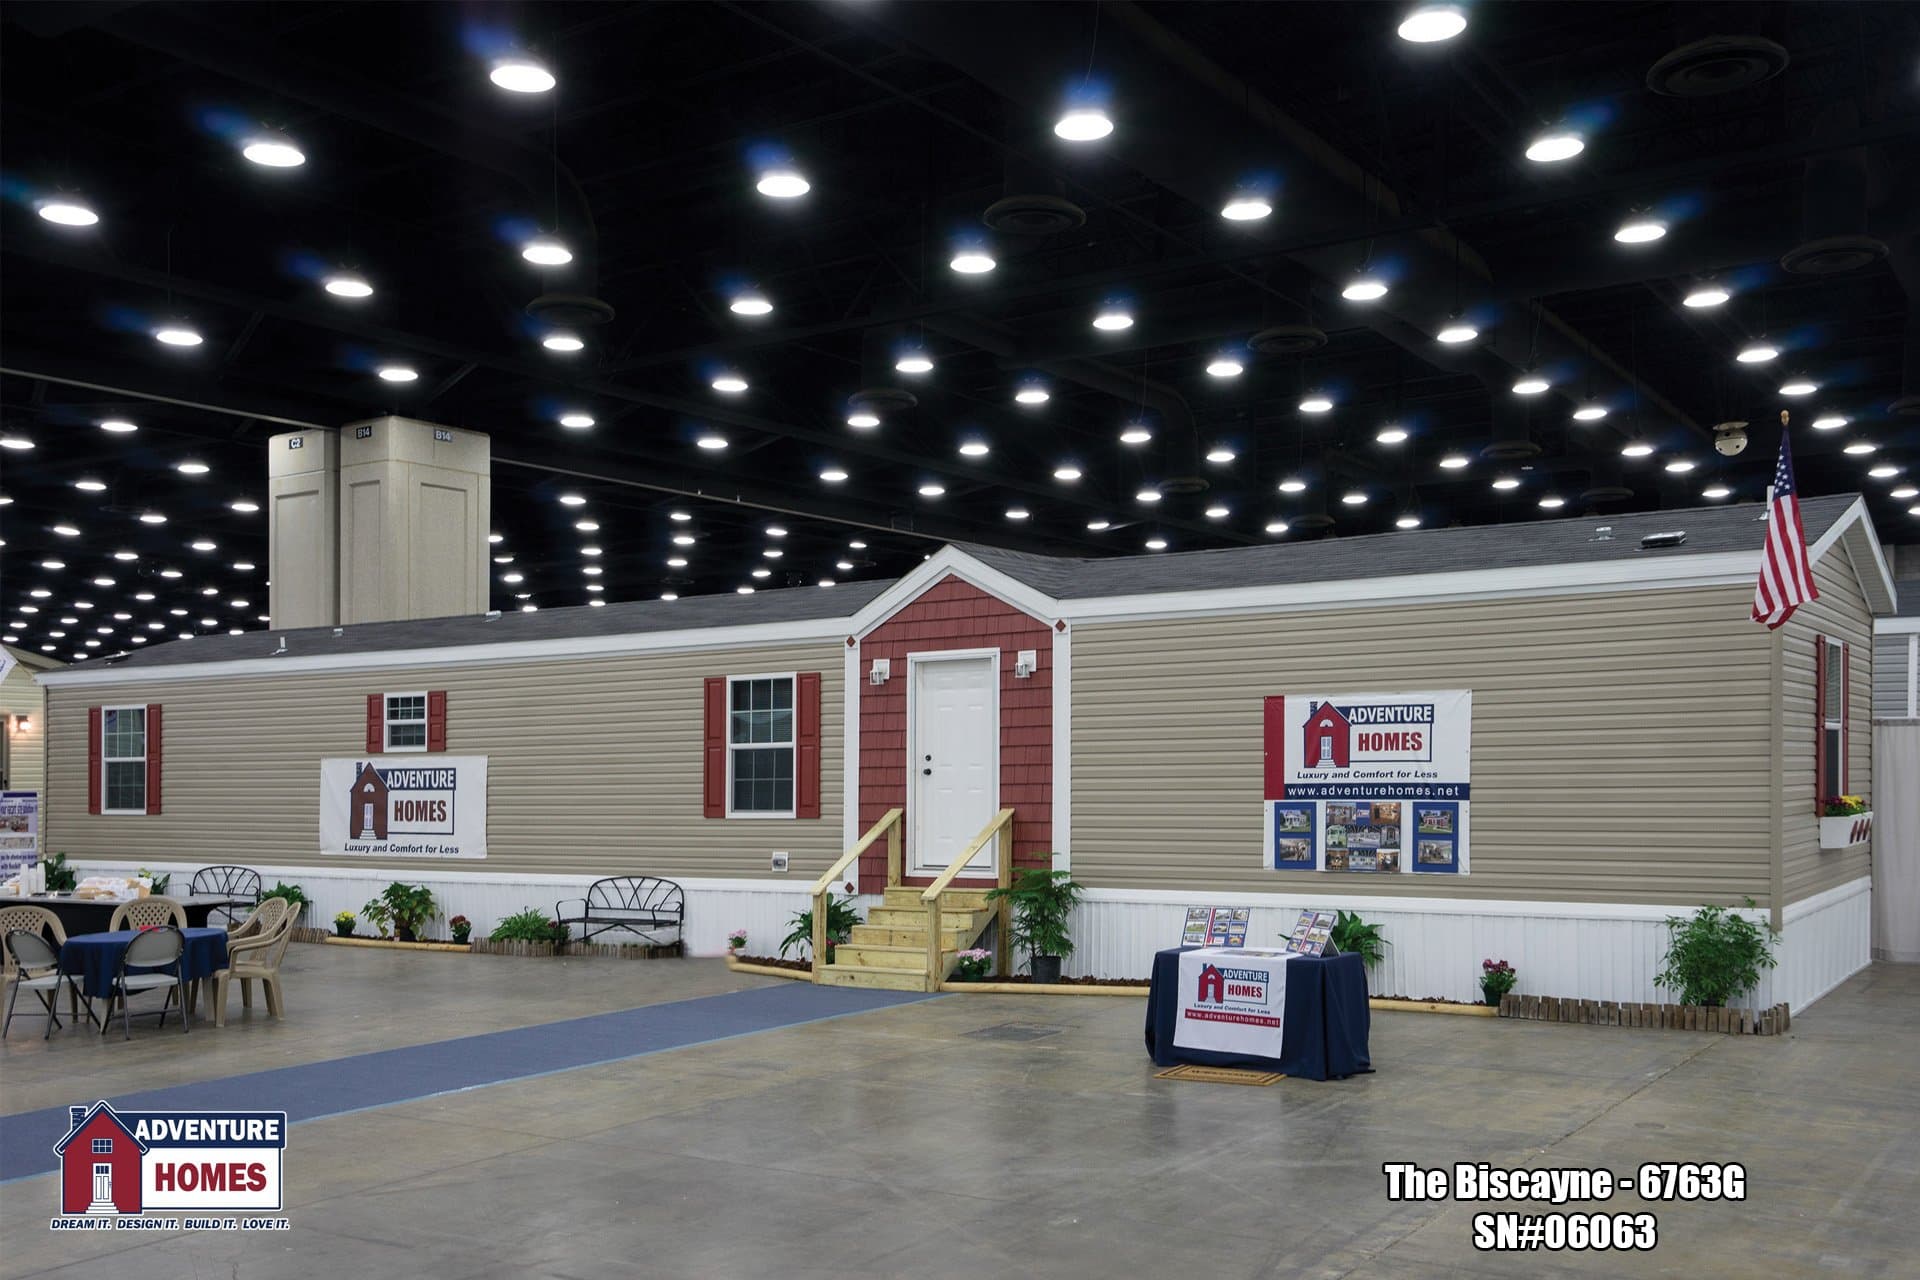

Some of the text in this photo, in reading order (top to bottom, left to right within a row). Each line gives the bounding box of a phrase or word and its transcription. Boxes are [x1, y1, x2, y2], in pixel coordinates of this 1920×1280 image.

[357, 428, 370, 438] B14
[435, 430, 451, 441] B14
[290, 439, 301, 448] C2
[1348, 706, 1432, 723] ADVENTURE
[1358, 732, 1423, 751] HOMES
[386, 769, 454, 788] ADVENTURE
[1297, 770, 1438, 780] Luxury and Comfort for Less
[1287, 785, 1460, 796] www.adventurehomes.net
[394, 800, 447, 822] HOMES
[344, 843, 460, 854] Luxury and Comfort for Less
[1223, 968, 1268, 981] ADVENTURE
[1228, 984, 1263, 998] HOMES
[1224, 1005, 1247, 1013] Comfort
[1187, 1011, 1280, 1026] www.adventurehomes.net
